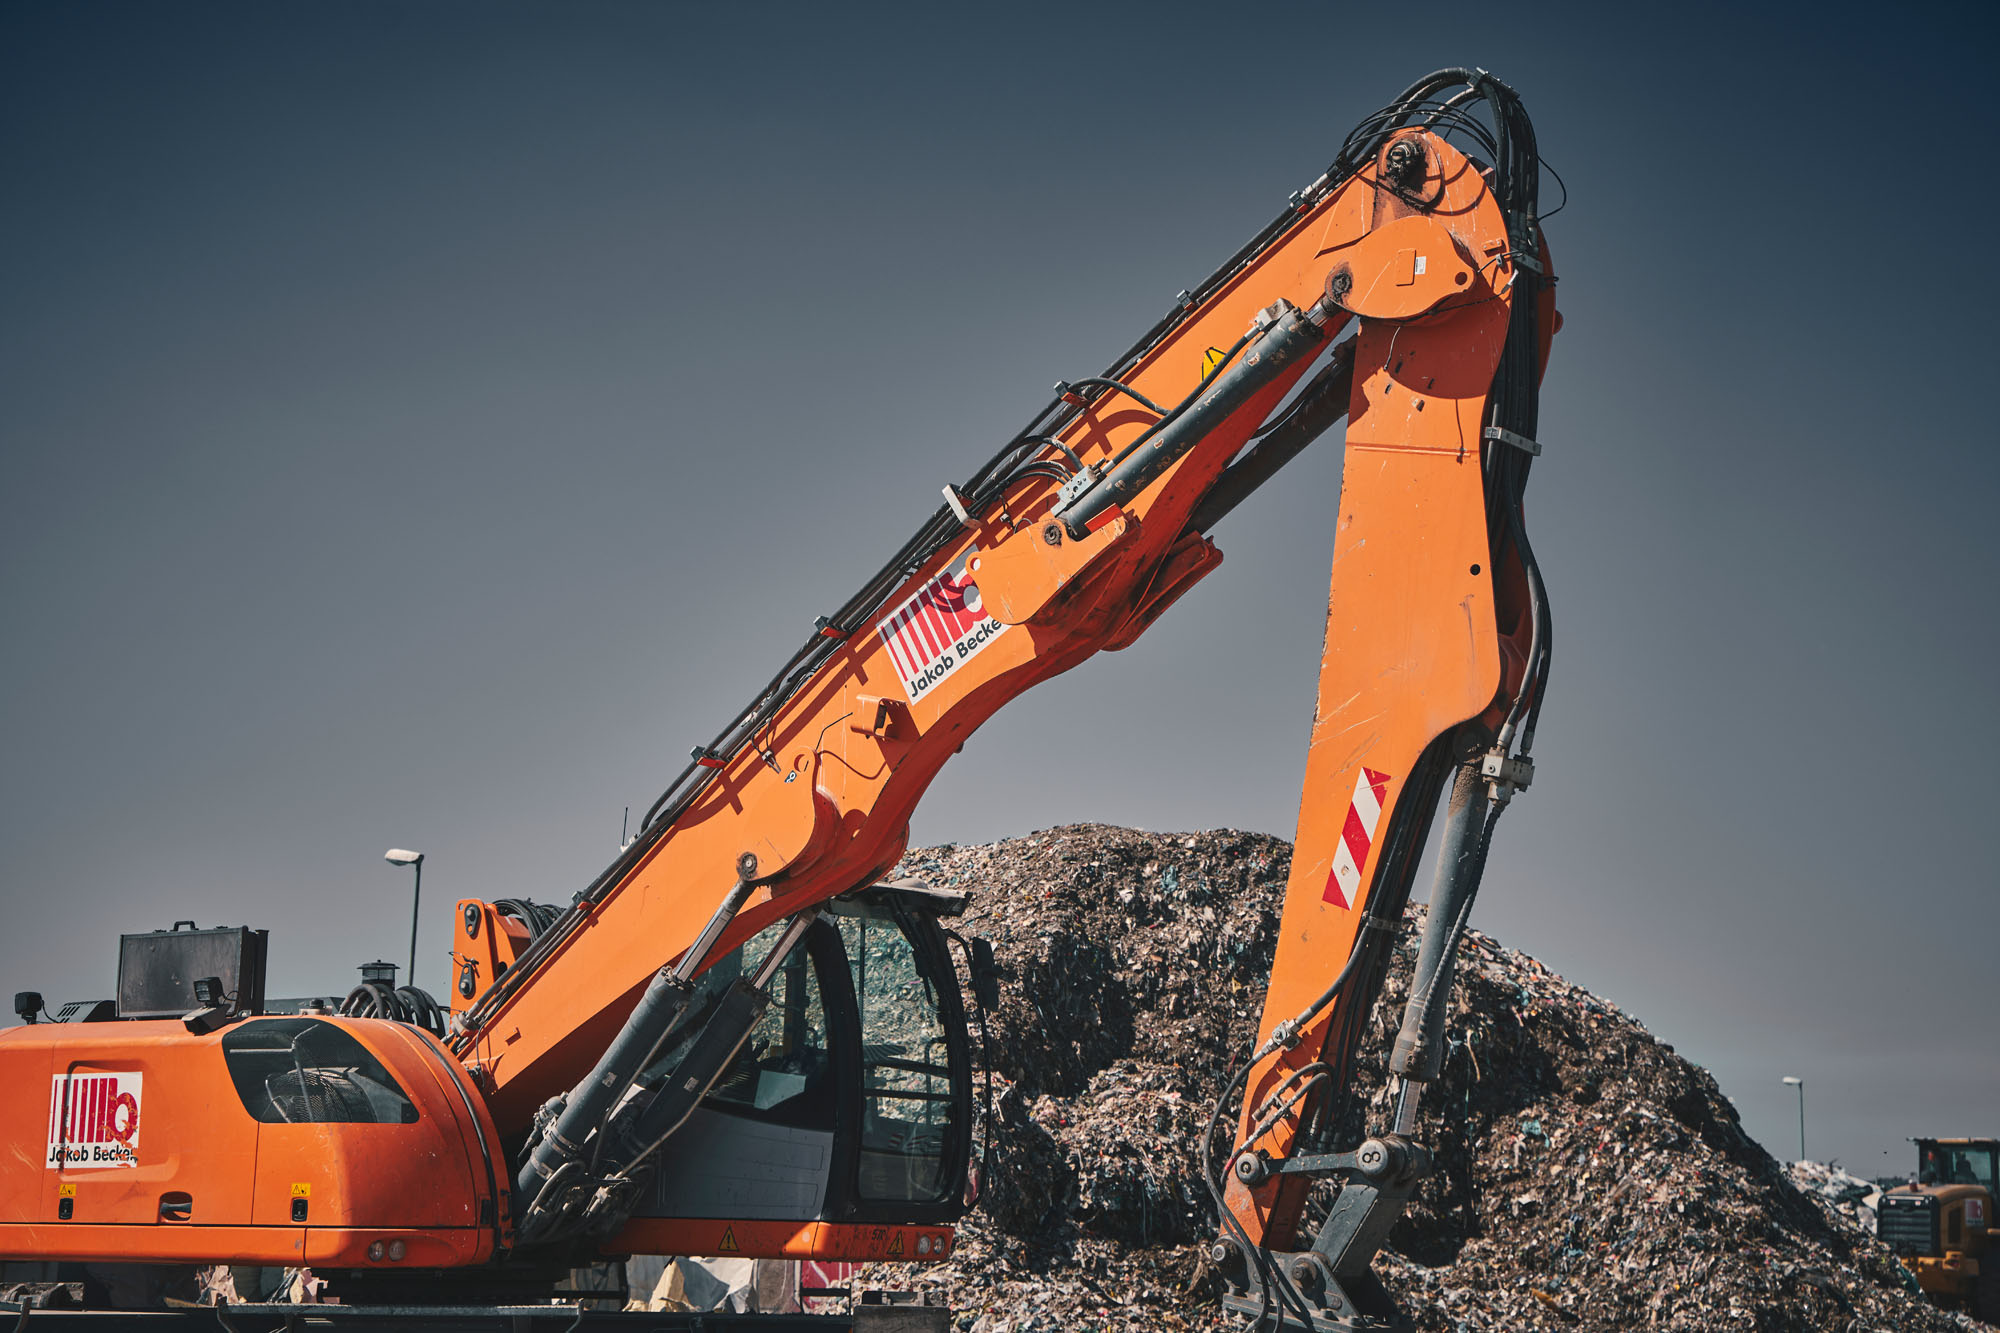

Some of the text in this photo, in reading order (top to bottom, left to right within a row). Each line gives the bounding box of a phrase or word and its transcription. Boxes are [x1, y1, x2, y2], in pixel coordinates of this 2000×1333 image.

[911, 619, 1002, 697] Jakob Becke
[49, 1146, 88, 1162] Jakob
